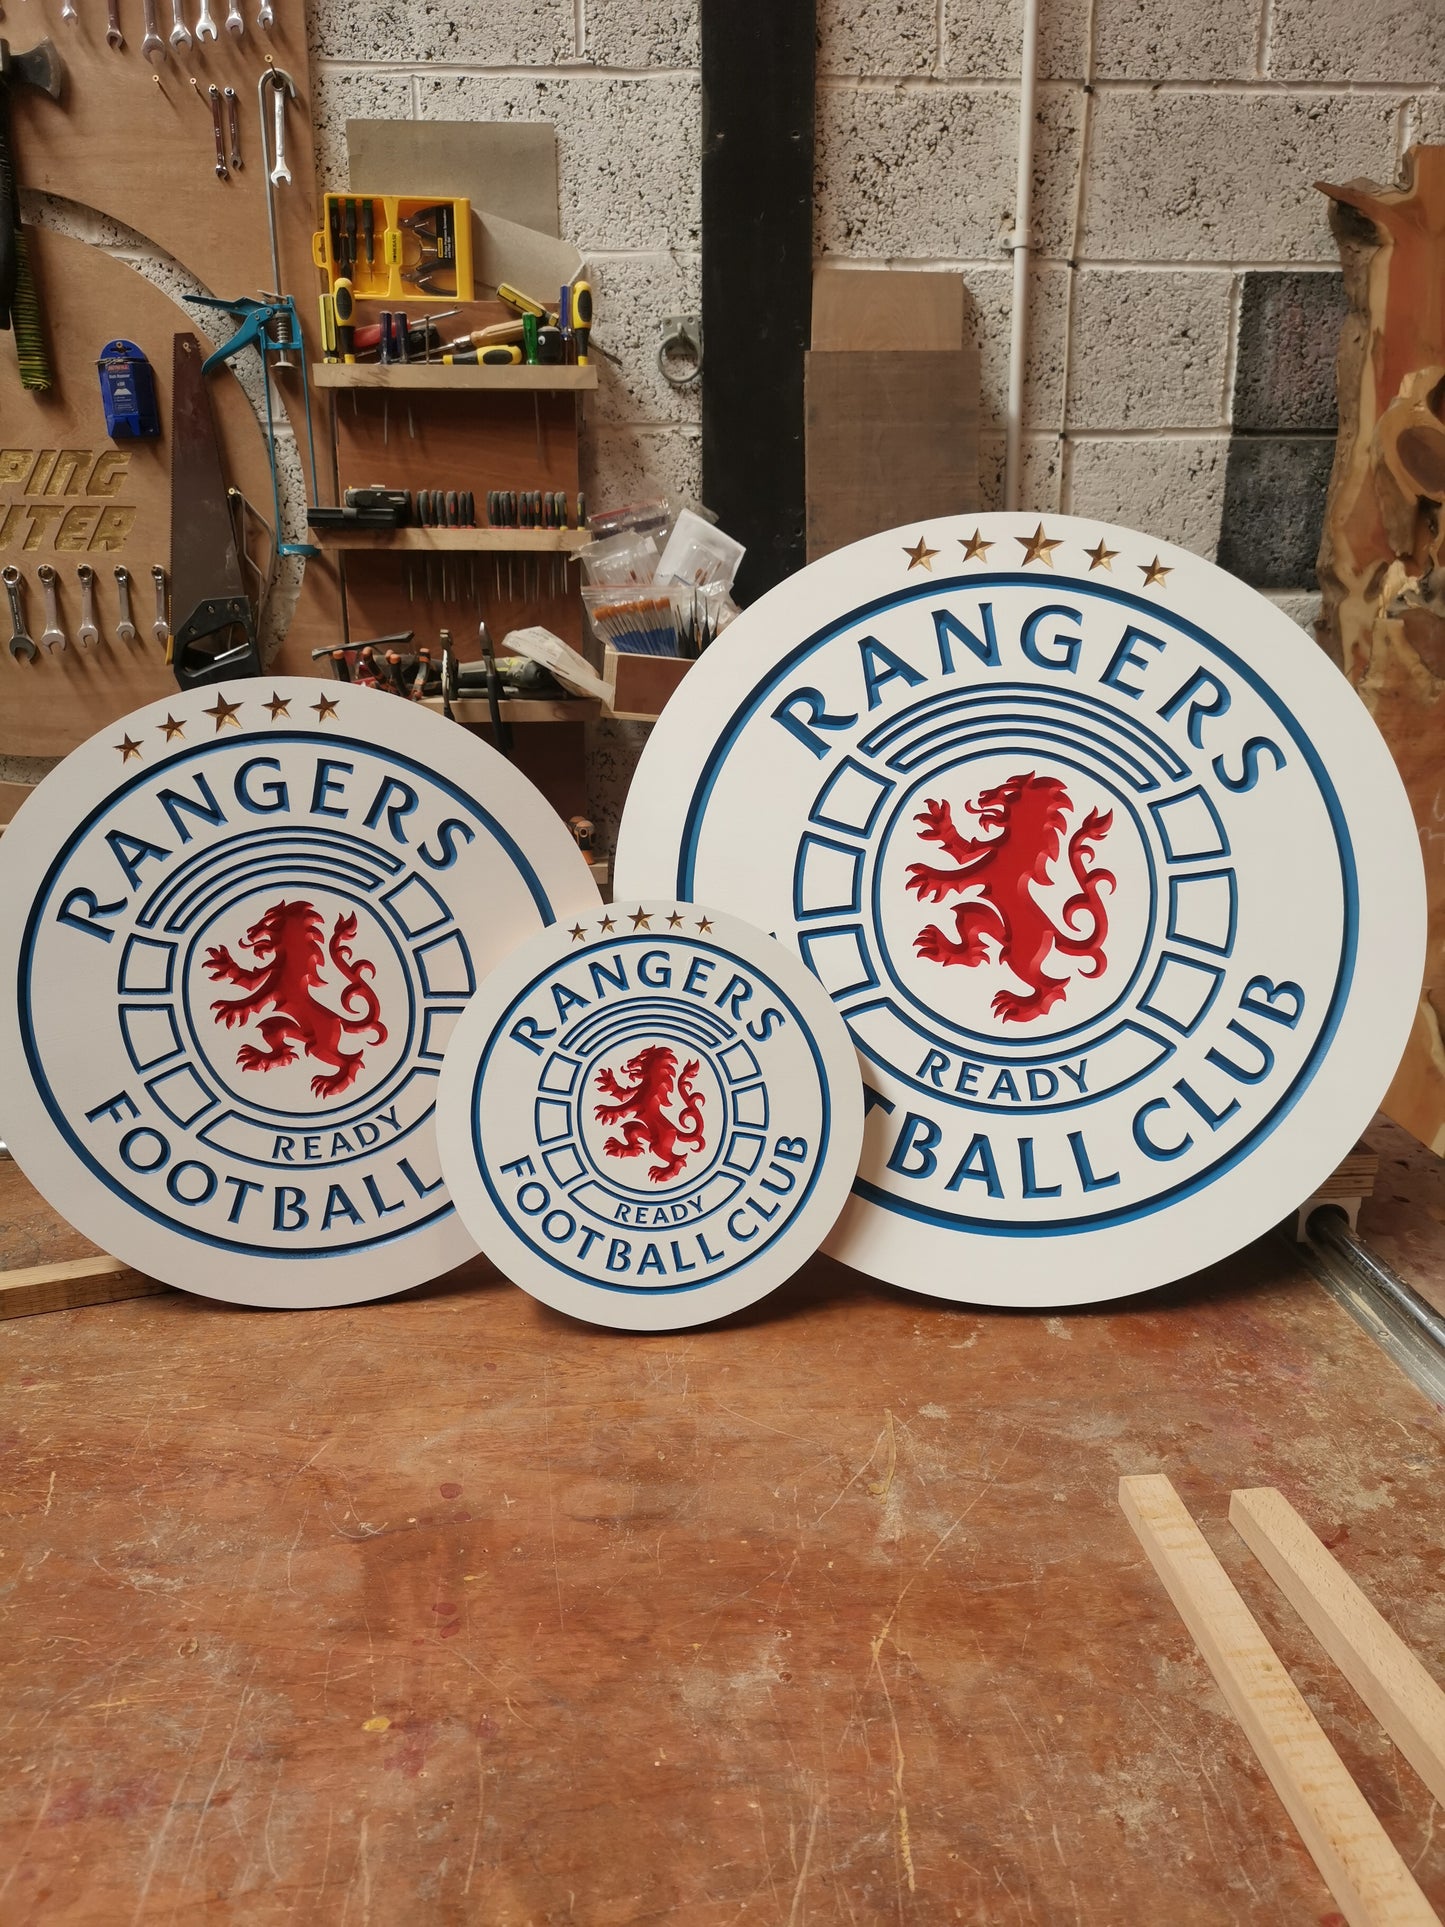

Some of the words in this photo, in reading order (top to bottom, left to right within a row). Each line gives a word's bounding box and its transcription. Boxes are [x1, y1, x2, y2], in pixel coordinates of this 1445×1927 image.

[0, 504, 136, 552] ITER
[771, 603, 1286, 794] RANGERS
[56, 757, 475, 943] RANGERS
[509, 949, 785, 1056] RANGERS
[915, 1049, 1089, 1102] READY
[1133, 975, 1306, 1163] CLUB
[85, 1090, 444, 1232] FOOTBALL
[272, 1105, 402, 1162] READY
[500, 1154, 724, 1276] FOOTBALL
[727, 1135, 808, 1242] CLUB
[613, 1194, 704, 1225] READY
